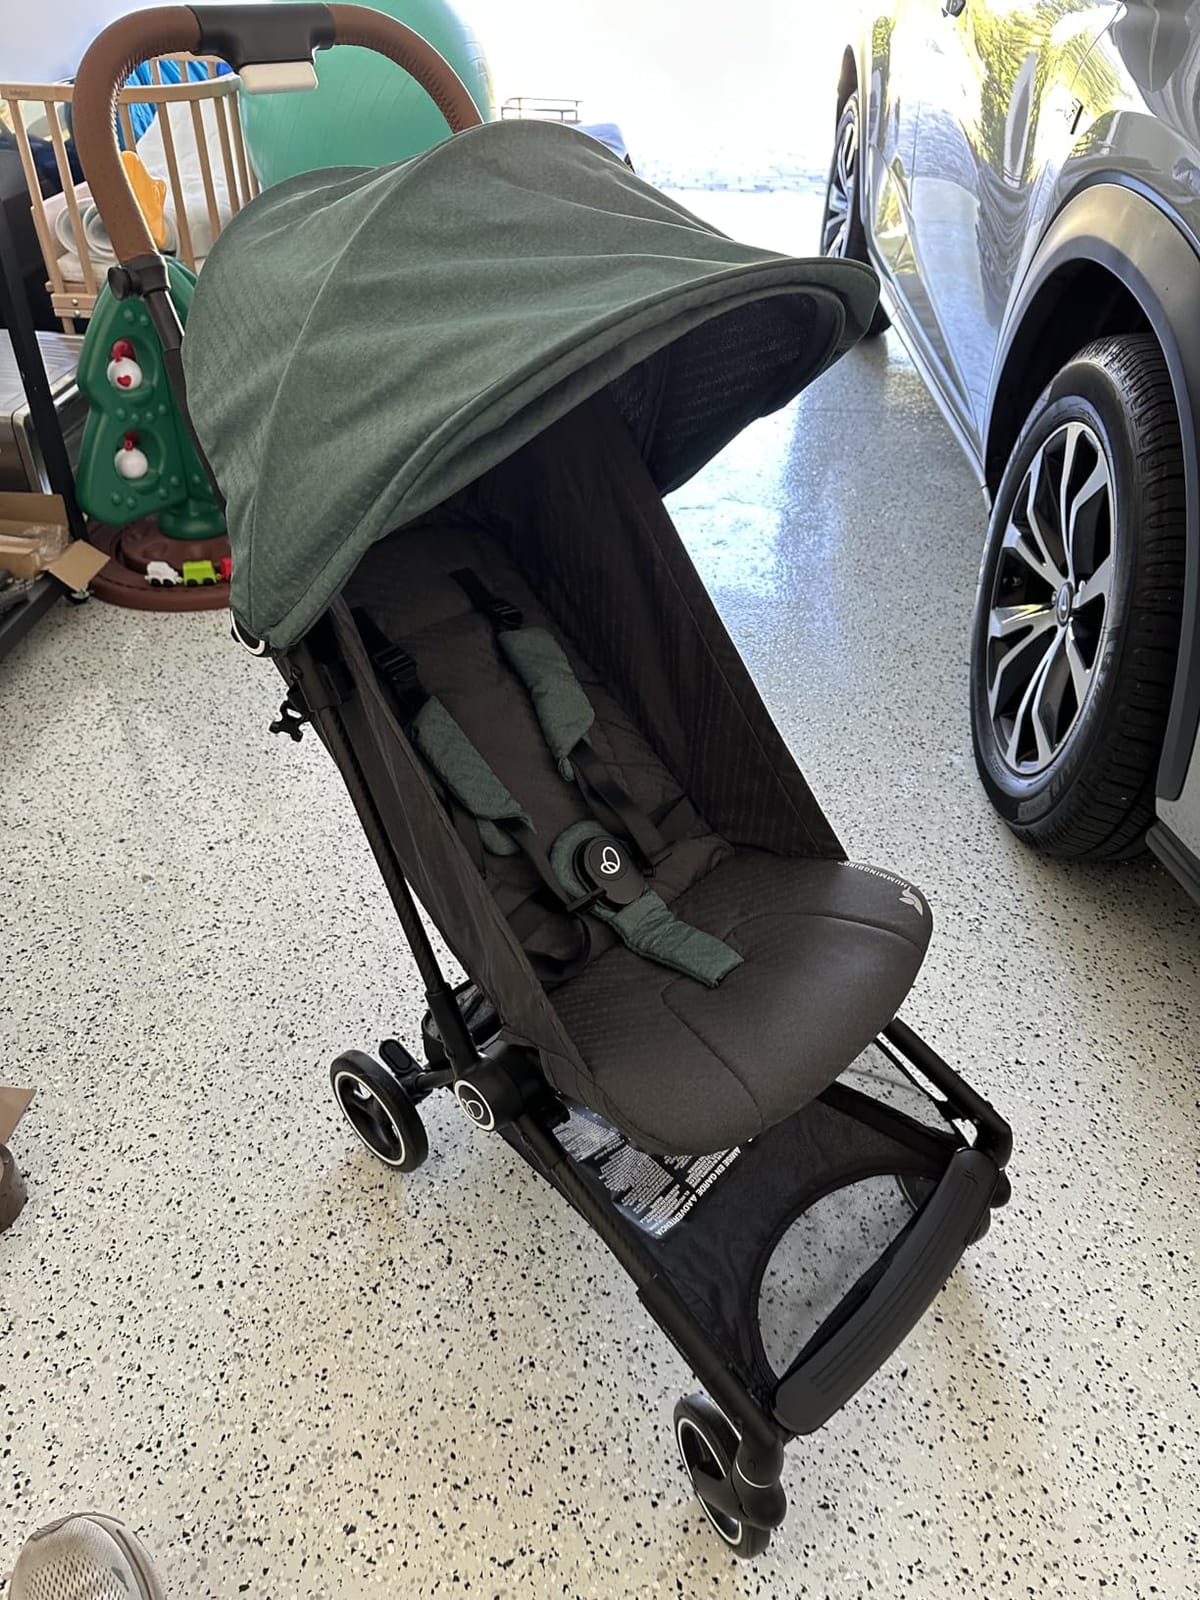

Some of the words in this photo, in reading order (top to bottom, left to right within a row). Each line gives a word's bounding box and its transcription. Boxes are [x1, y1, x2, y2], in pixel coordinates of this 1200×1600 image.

[714, 1163, 726, 1176] EN
[695, 1172, 718, 1197] GARDE
[655, 1199, 694, 1236] ADVERTENCIA
